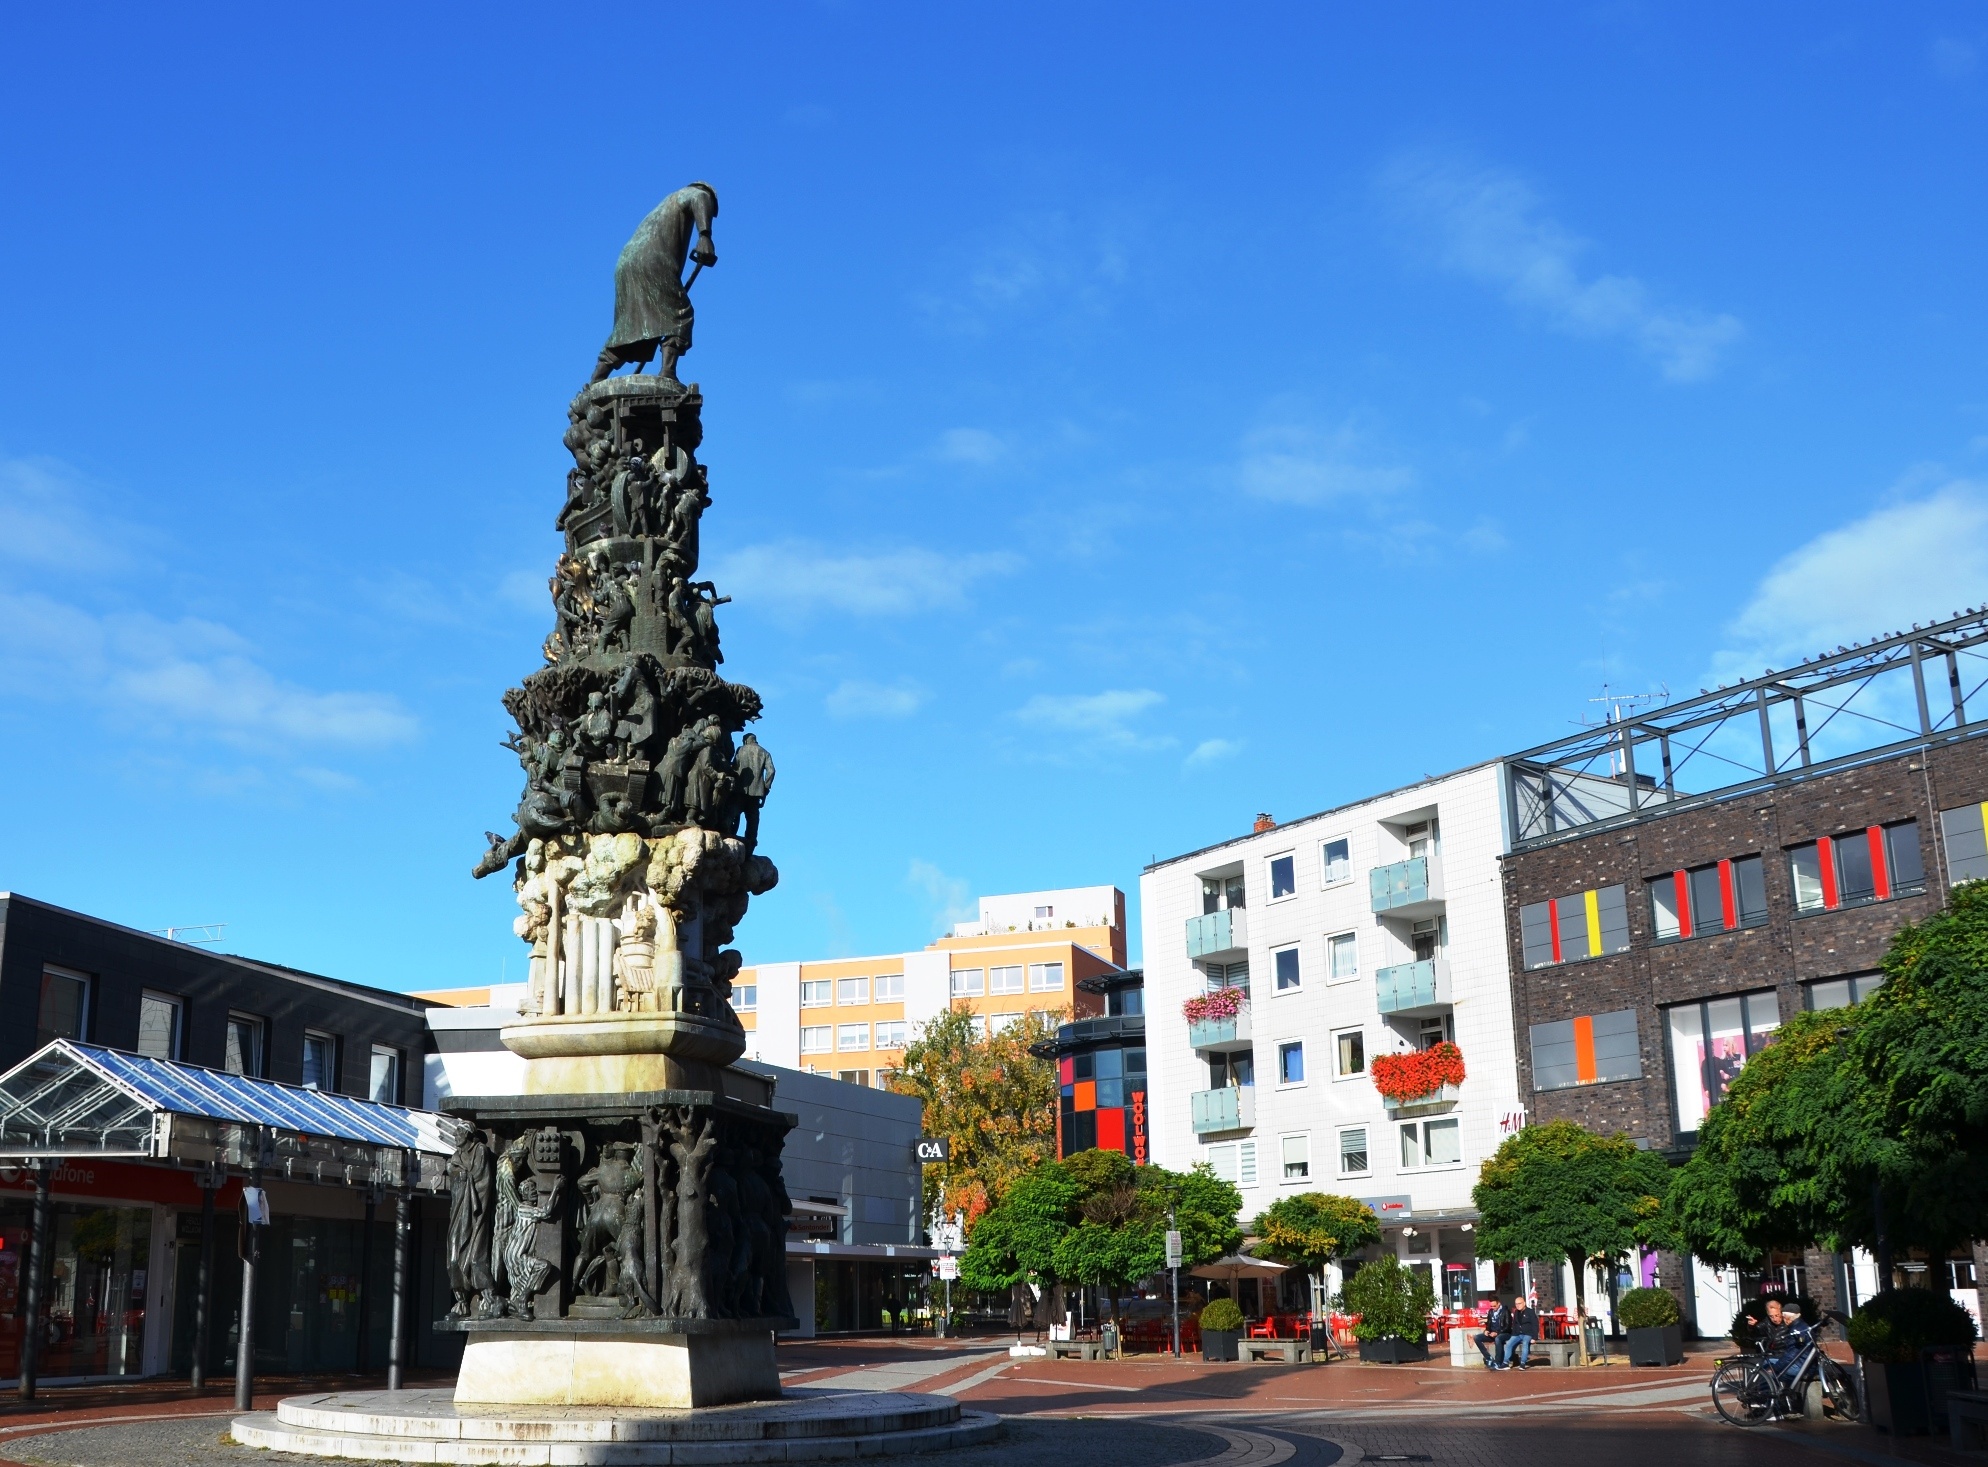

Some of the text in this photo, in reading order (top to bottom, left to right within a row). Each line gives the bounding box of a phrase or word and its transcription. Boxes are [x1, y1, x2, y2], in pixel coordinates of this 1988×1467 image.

[1500, 1112, 1522, 1133] H&M
[917, 1142, 943, 1158] C&A
[26, 1163, 95, 1184] vafone
